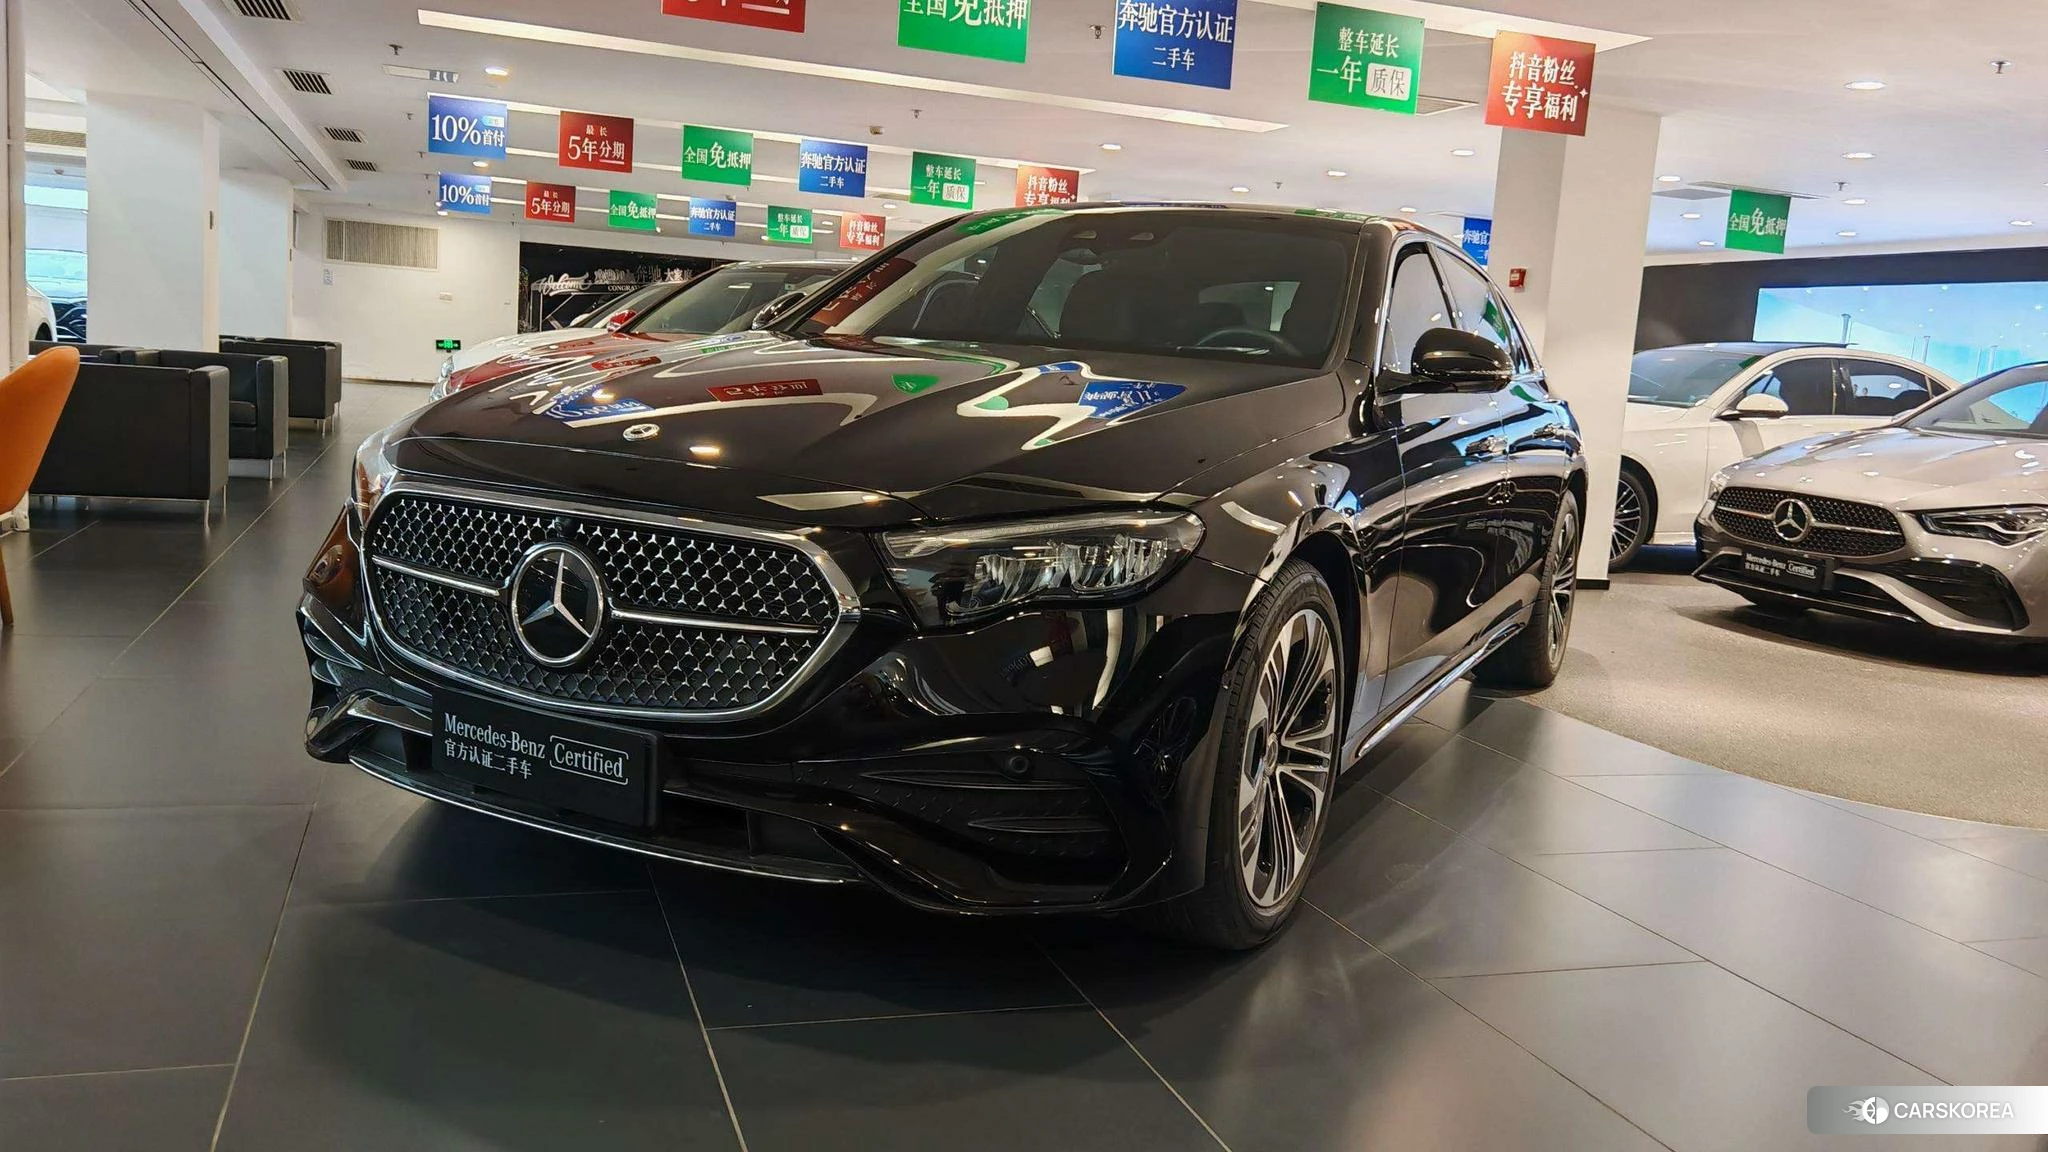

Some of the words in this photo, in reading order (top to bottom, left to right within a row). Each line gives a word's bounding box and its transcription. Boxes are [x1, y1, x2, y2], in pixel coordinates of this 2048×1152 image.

[1118, 0, 1234, 44] 奔驰官方认证
[1338, 26, 1400, 59] 整车延长
[1152, 47, 1195, 71] 二手车
[1508, 51, 1576, 85] 抖音粉丝
[1501, 80, 1579, 122] 专享福利
[567, 135, 625, 162] 5年分期
[684, 141, 751, 170] 全国免抵押
[801, 151, 866, 175] 奔驰官方认证
[820, 175, 845, 190] 二手车
[1027, 174, 1068, 193] 抖音粉丝
[530, 197, 570, 216] 5年分期
[1728, 207, 1787, 237] 全国免抵押
[1464, 228, 1490, 246] 奔驰官
[444, 712, 546, 759] Mercedes-Benz
[554, 742, 623, 778] Certified
[444, 738, 532, 780] 官方认证二手车
